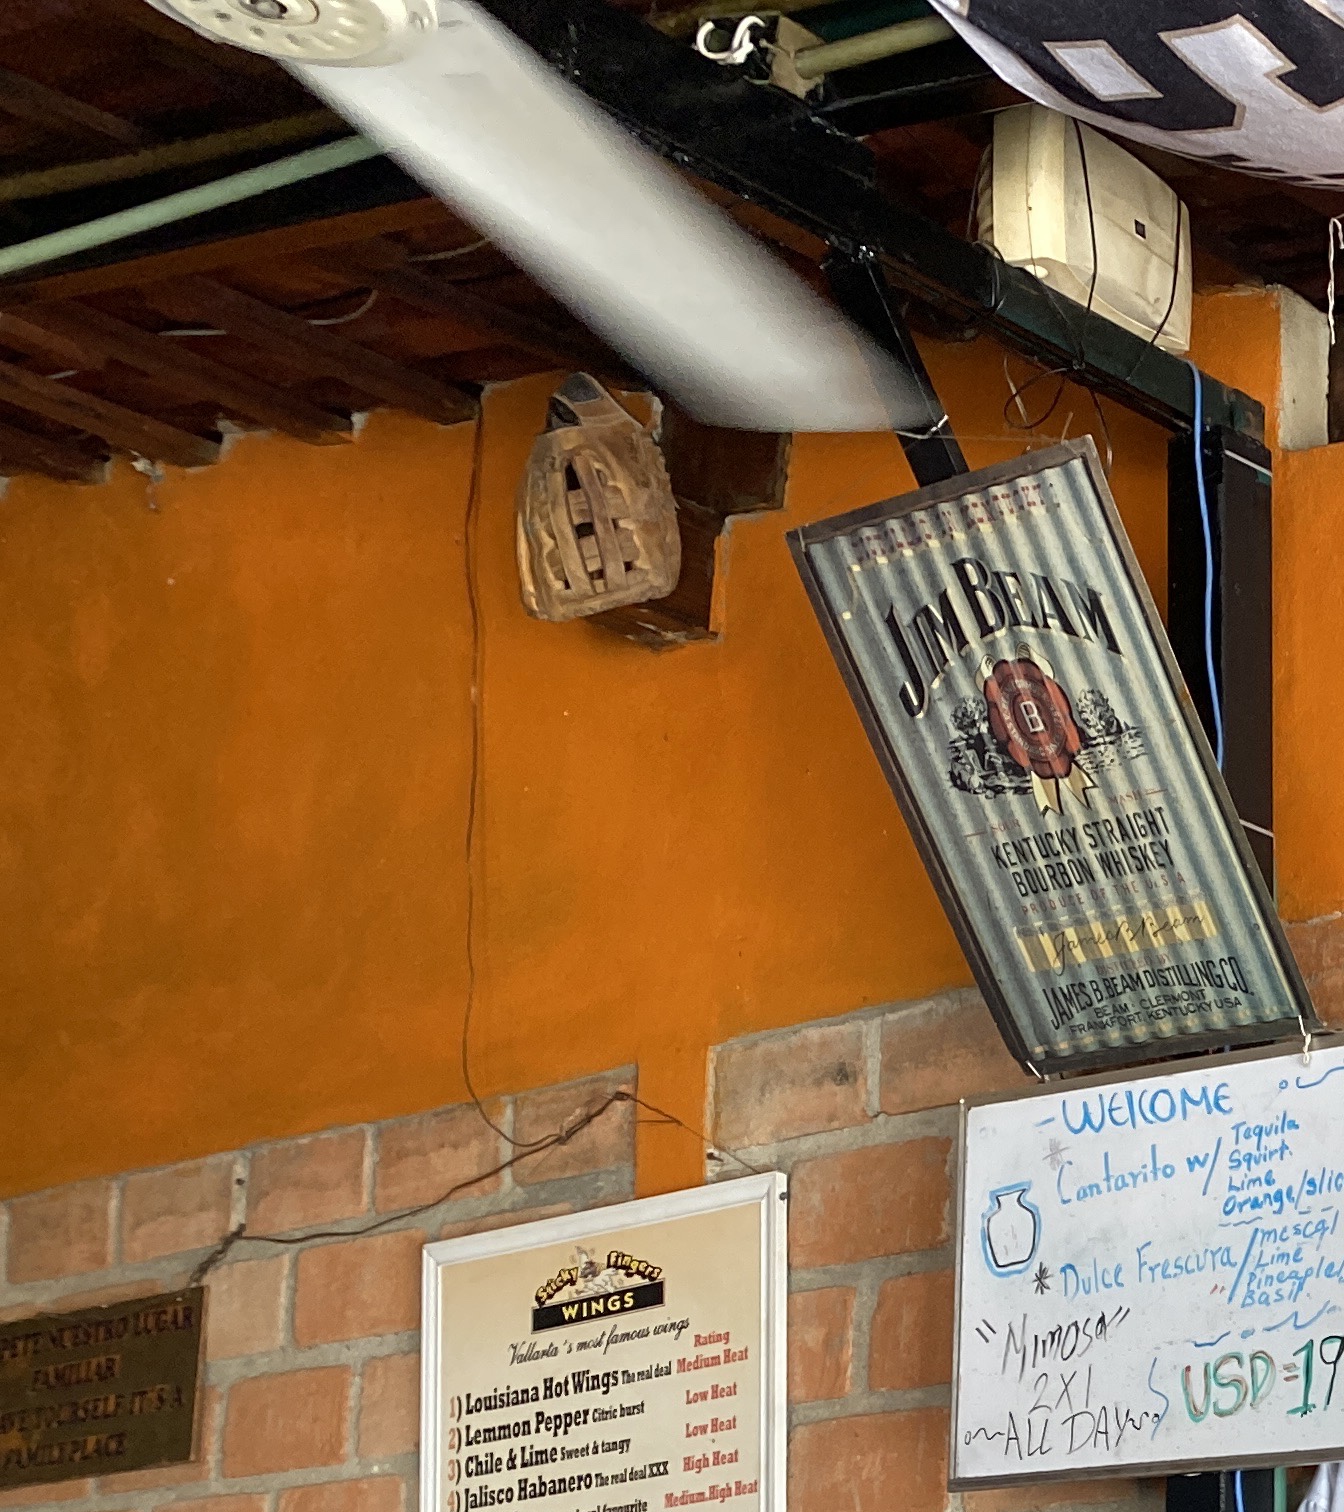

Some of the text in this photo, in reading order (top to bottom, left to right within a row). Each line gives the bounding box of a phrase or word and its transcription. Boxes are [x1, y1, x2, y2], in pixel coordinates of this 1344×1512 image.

[886, 589, 970, 719] JIM
[950, 558, 1122, 656] BEAM
[991, 806, 1170, 870] KENTUCKY STRAIGHT
[1011, 839, 1174, 897] BOURBON WHISKEY
[1112, 882, 1139, 896] THE
[1042, 982, 1094, 1030] JAMES
[1102, 973, 1145, 999] BEAM
[1143, 960, 1223, 988] DISTILLING
[1094, 989, 1207, 1018] BEAM CLERMONT
[1148, 997, 1242, 1020] KENTUCKY USA
[1232, 1111, 1299, 1150] Tequila
[1057, 1144, 1175, 1204] Cantarito
[1228, 1169, 1275, 1192] Lime
[537, 1251, 662, 1304] Sticky Fingers
[1060, 1240, 1237, 1297] Dulce Frescura
[1256, 1247, 1303, 1268] Lime
[562, 1292, 634, 1321] WINGS
[576, 1332, 606, 1353] most
[604, 1324, 650, 1355] famous
[653, 1317, 689, 1340] wings
[694, 1331, 730, 1347] Rating
[465, 1346, 748, 1415] Louisiana Hot Wings The real deal Medium Heat
[465, 1382, 737, 1446] Lemmon Pepper Citric burst Low Heat
[1062, 1406, 1134, 1455] DAY
[465, 1415, 737, 1478] Chile Lime Sweet tangy Low Heat
[518, 1473, 592, 1500] Habanero
[595, 1473, 609, 1487] The
[611, 1468, 627, 1485] real
[629, 1465, 646, 1481] deal
[648, 1461, 669, 1478] XXX
[683, 1453, 709, 1474] High
[713, 1449, 739, 1466] Heat
[735, 1480, 758, 1496] Heat
